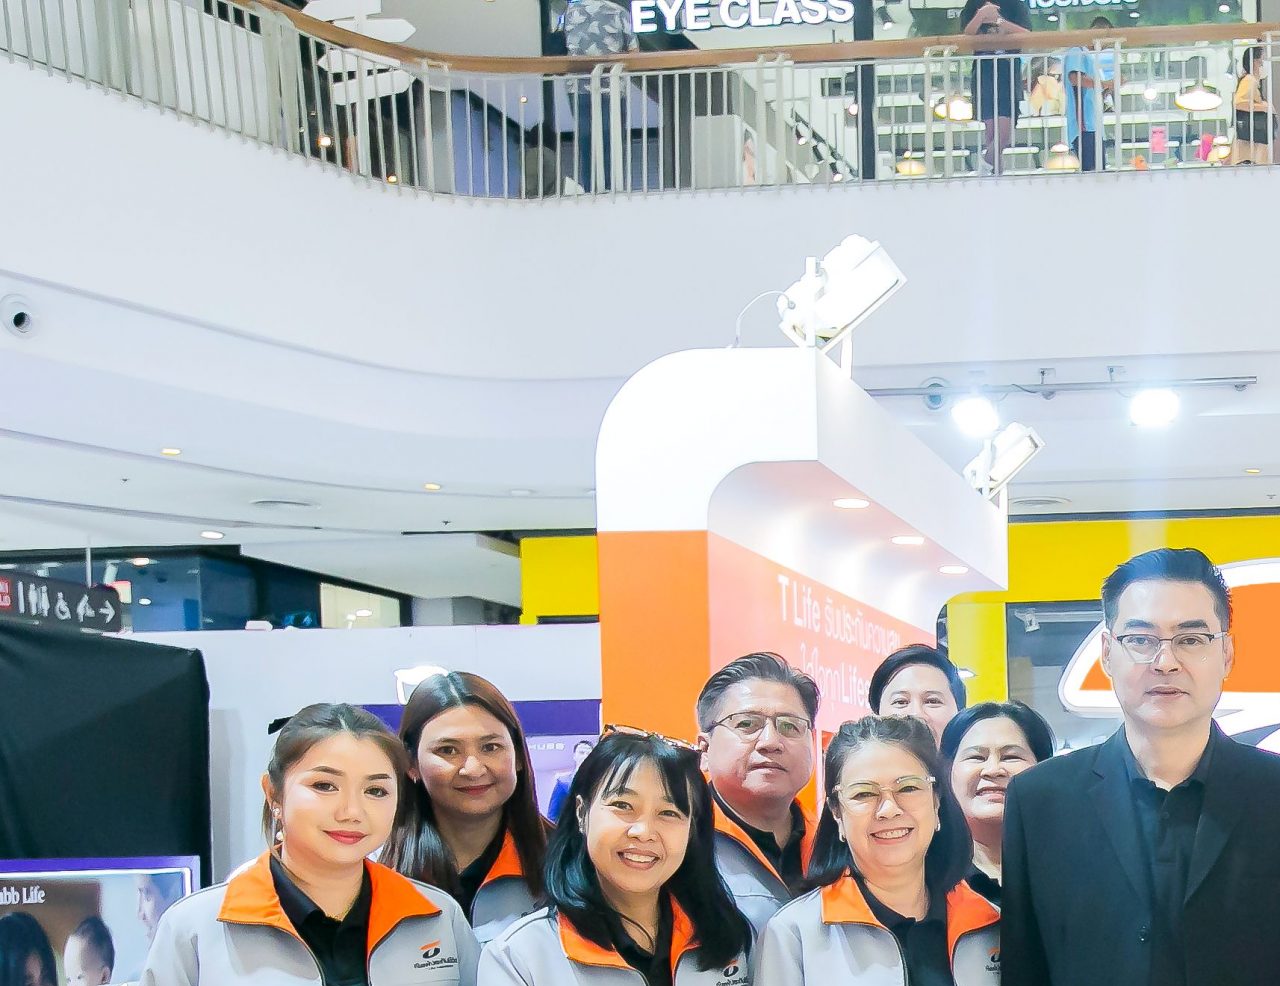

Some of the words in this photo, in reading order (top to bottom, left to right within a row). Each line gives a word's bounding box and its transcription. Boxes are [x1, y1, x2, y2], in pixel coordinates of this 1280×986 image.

[631, 0, 711, 33] EYE
[777, 573, 790, 622] T
[793, 580, 821, 633] Life
[22, 884, 46, 904] Life
